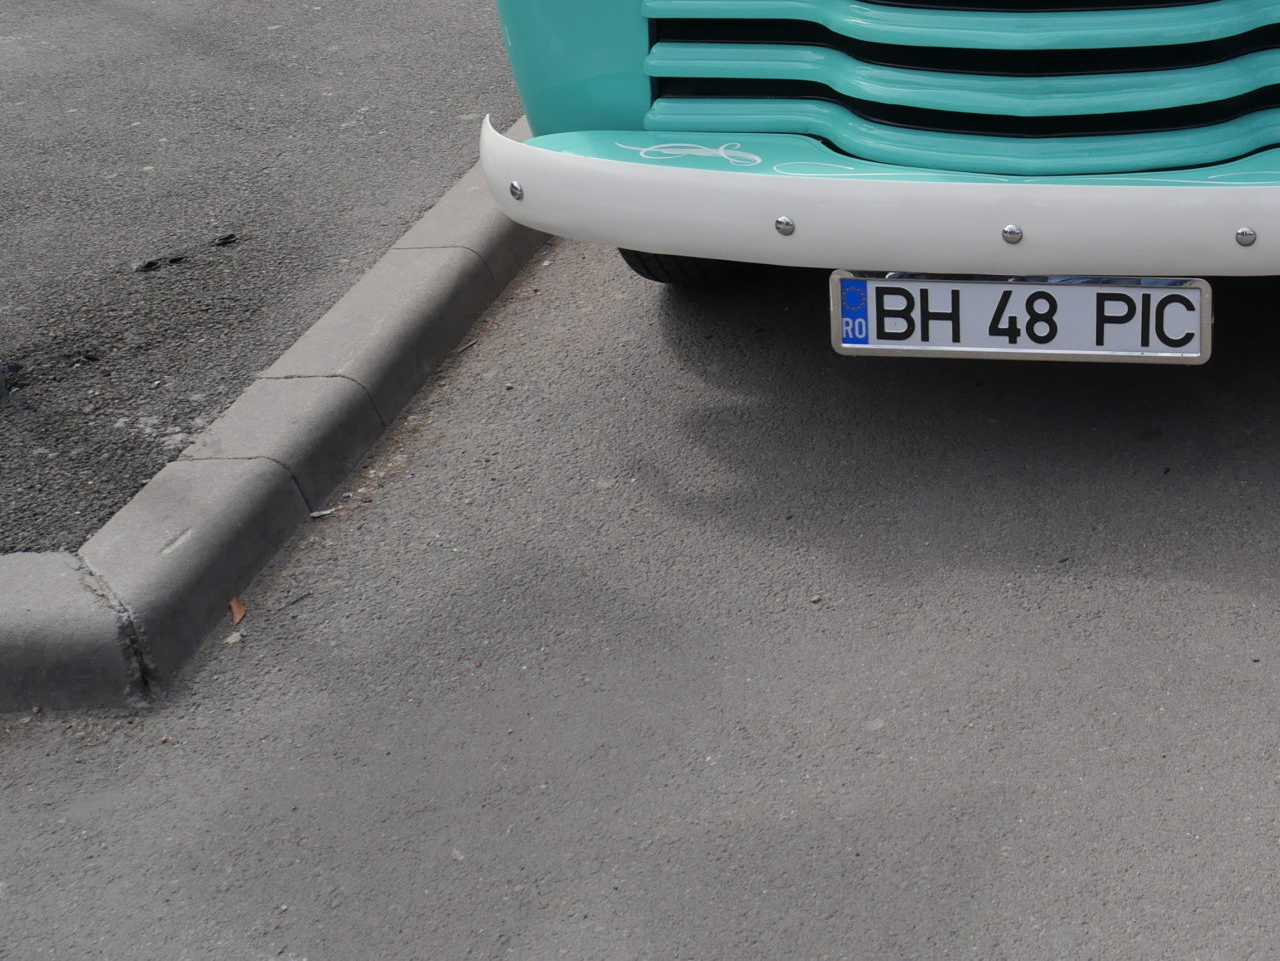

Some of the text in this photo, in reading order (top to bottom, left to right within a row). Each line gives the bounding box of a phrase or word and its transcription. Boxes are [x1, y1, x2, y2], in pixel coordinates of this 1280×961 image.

[842, 317, 866, 339] RO
[875, 286, 1196, 348] BH 48 PIC
